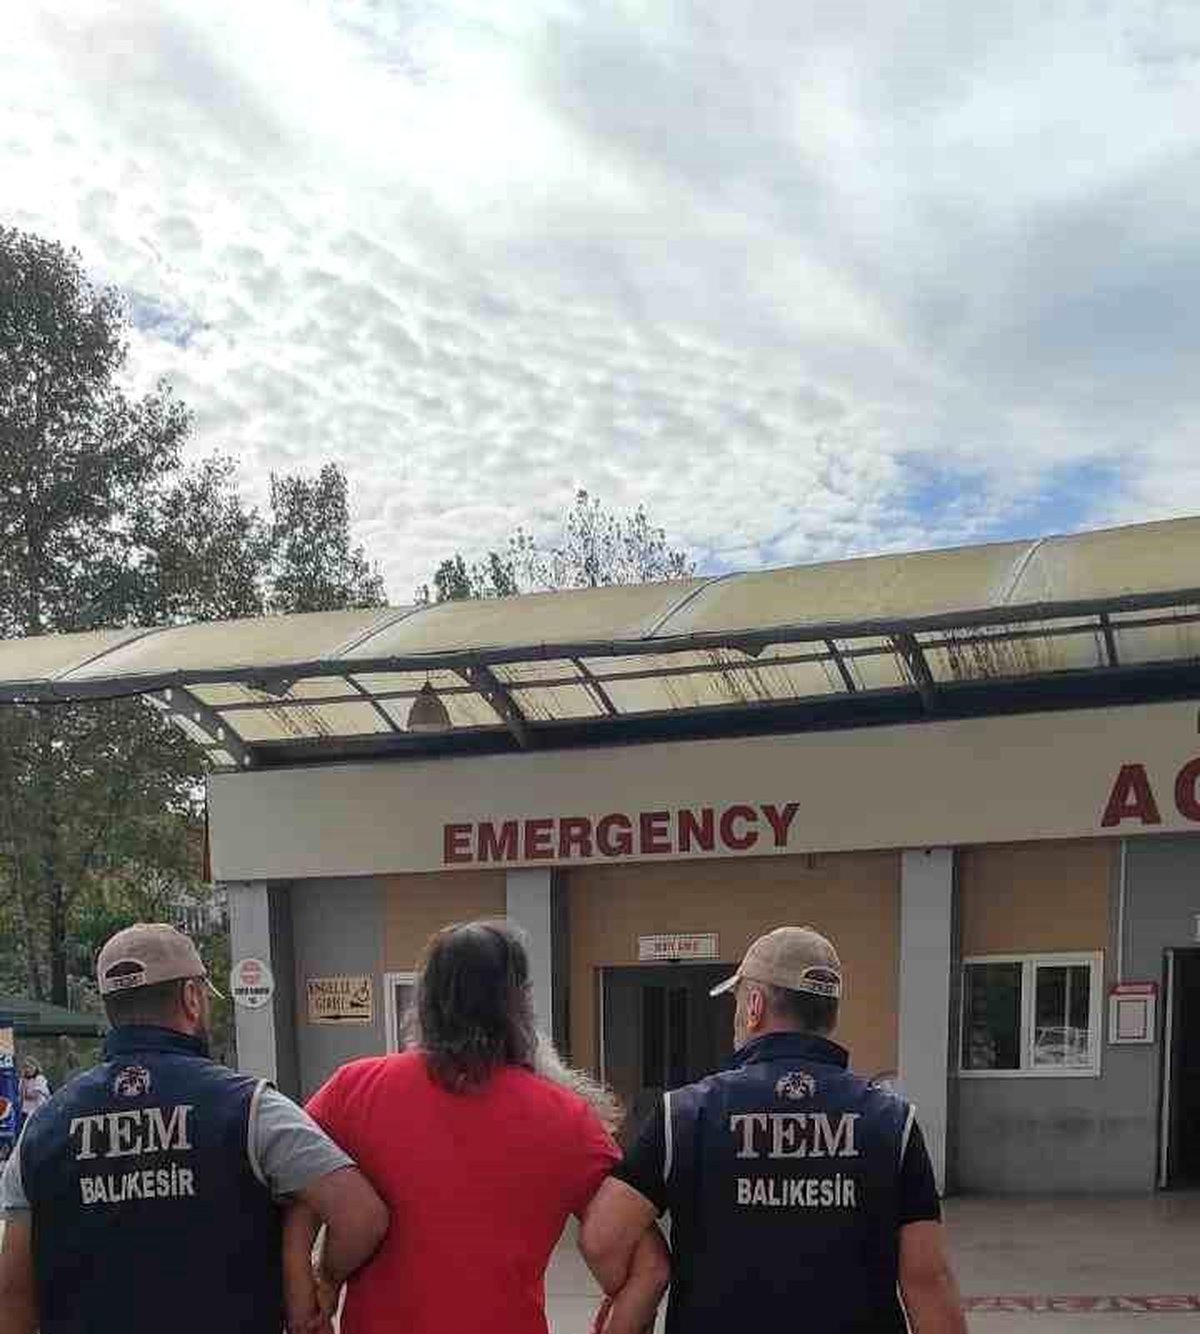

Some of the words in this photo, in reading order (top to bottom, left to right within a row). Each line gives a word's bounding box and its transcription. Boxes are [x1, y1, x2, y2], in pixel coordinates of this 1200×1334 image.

[444, 803, 800, 864] EMERGENCY
[69, 1105, 194, 1161] TEM
[730, 1112, 861, 1158] TEM
[80, 1162, 196, 1204] BALIKESİR
[736, 1173, 857, 1208] BALIKESİR
